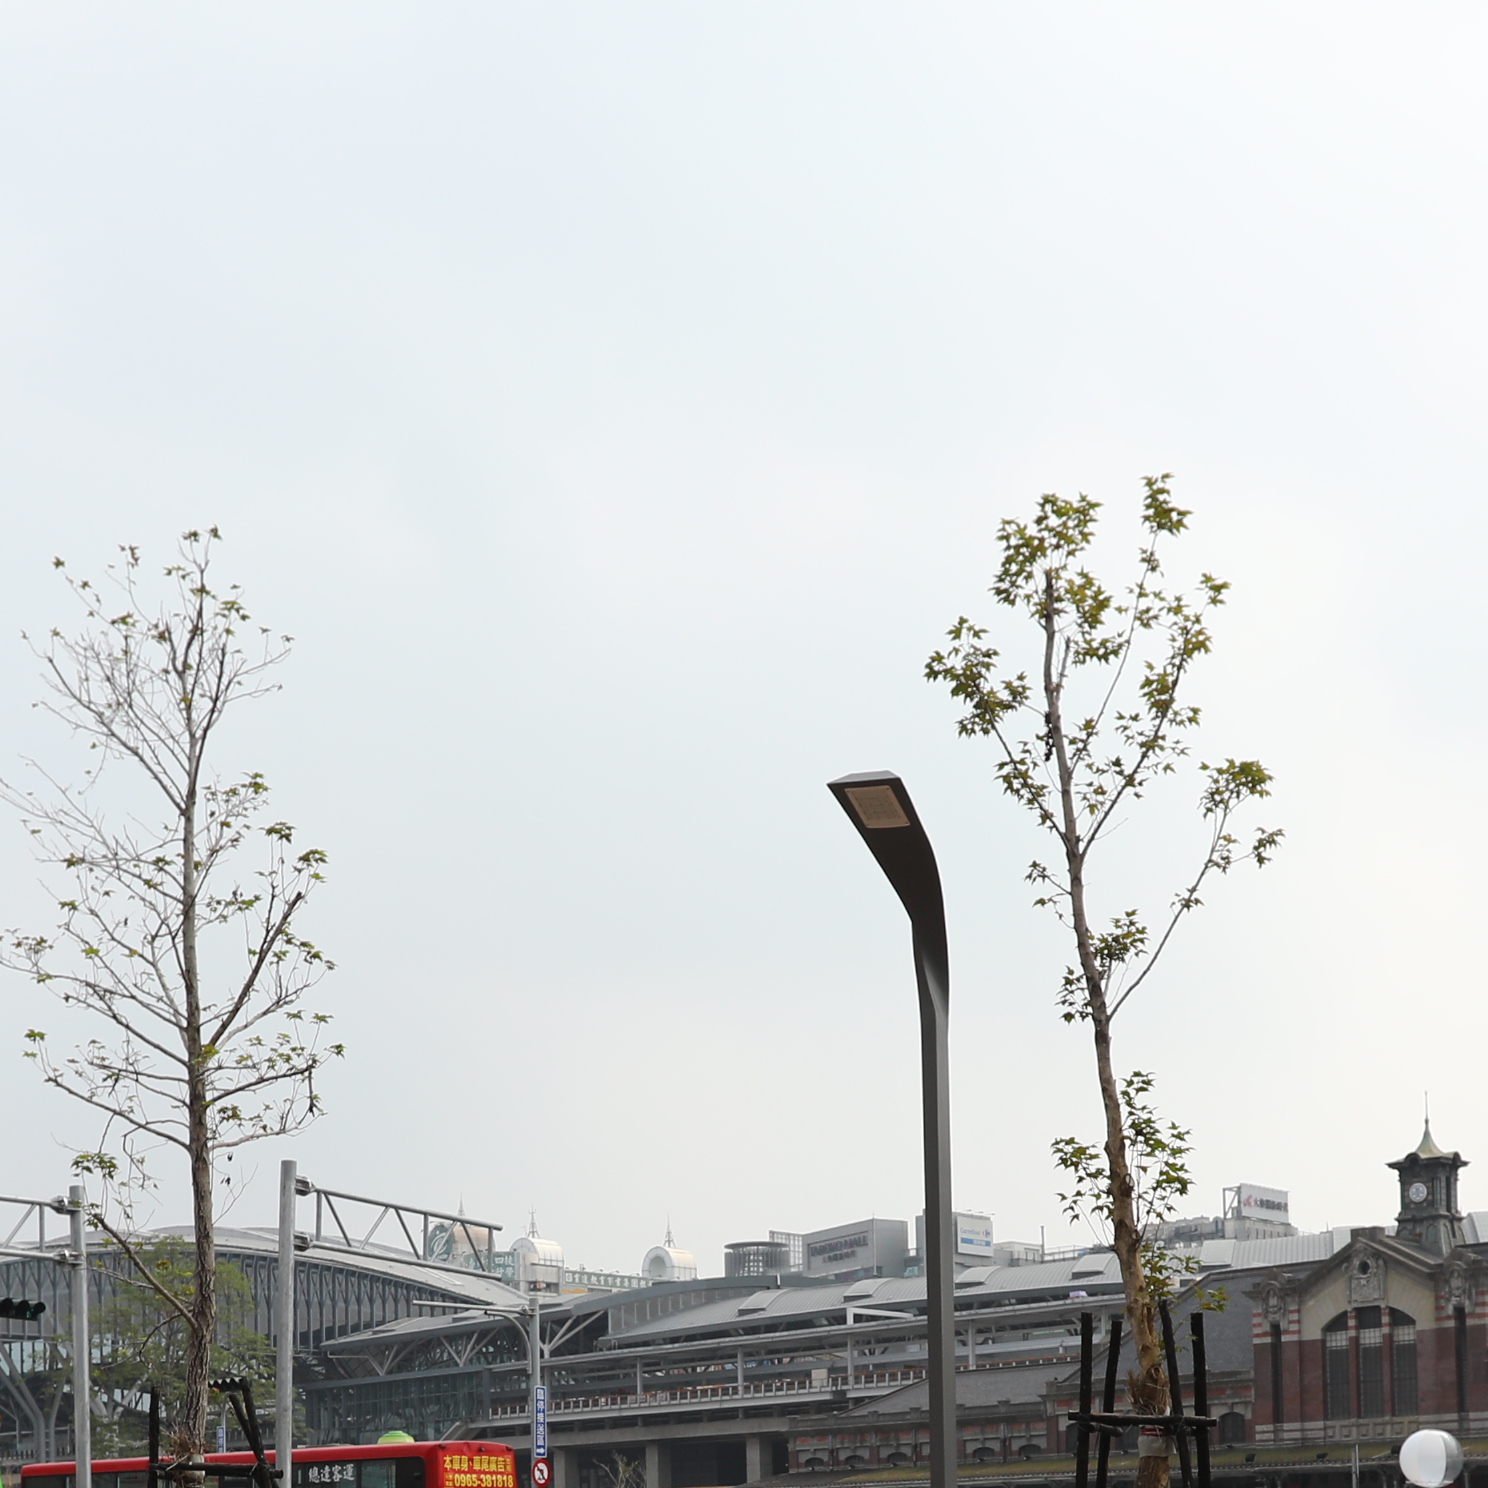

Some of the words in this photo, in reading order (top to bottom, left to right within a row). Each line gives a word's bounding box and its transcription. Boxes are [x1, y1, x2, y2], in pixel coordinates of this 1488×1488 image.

[308, 1463, 355, 1484] 總達客運
[455, 1474, 514, 1488] 0965-381818
